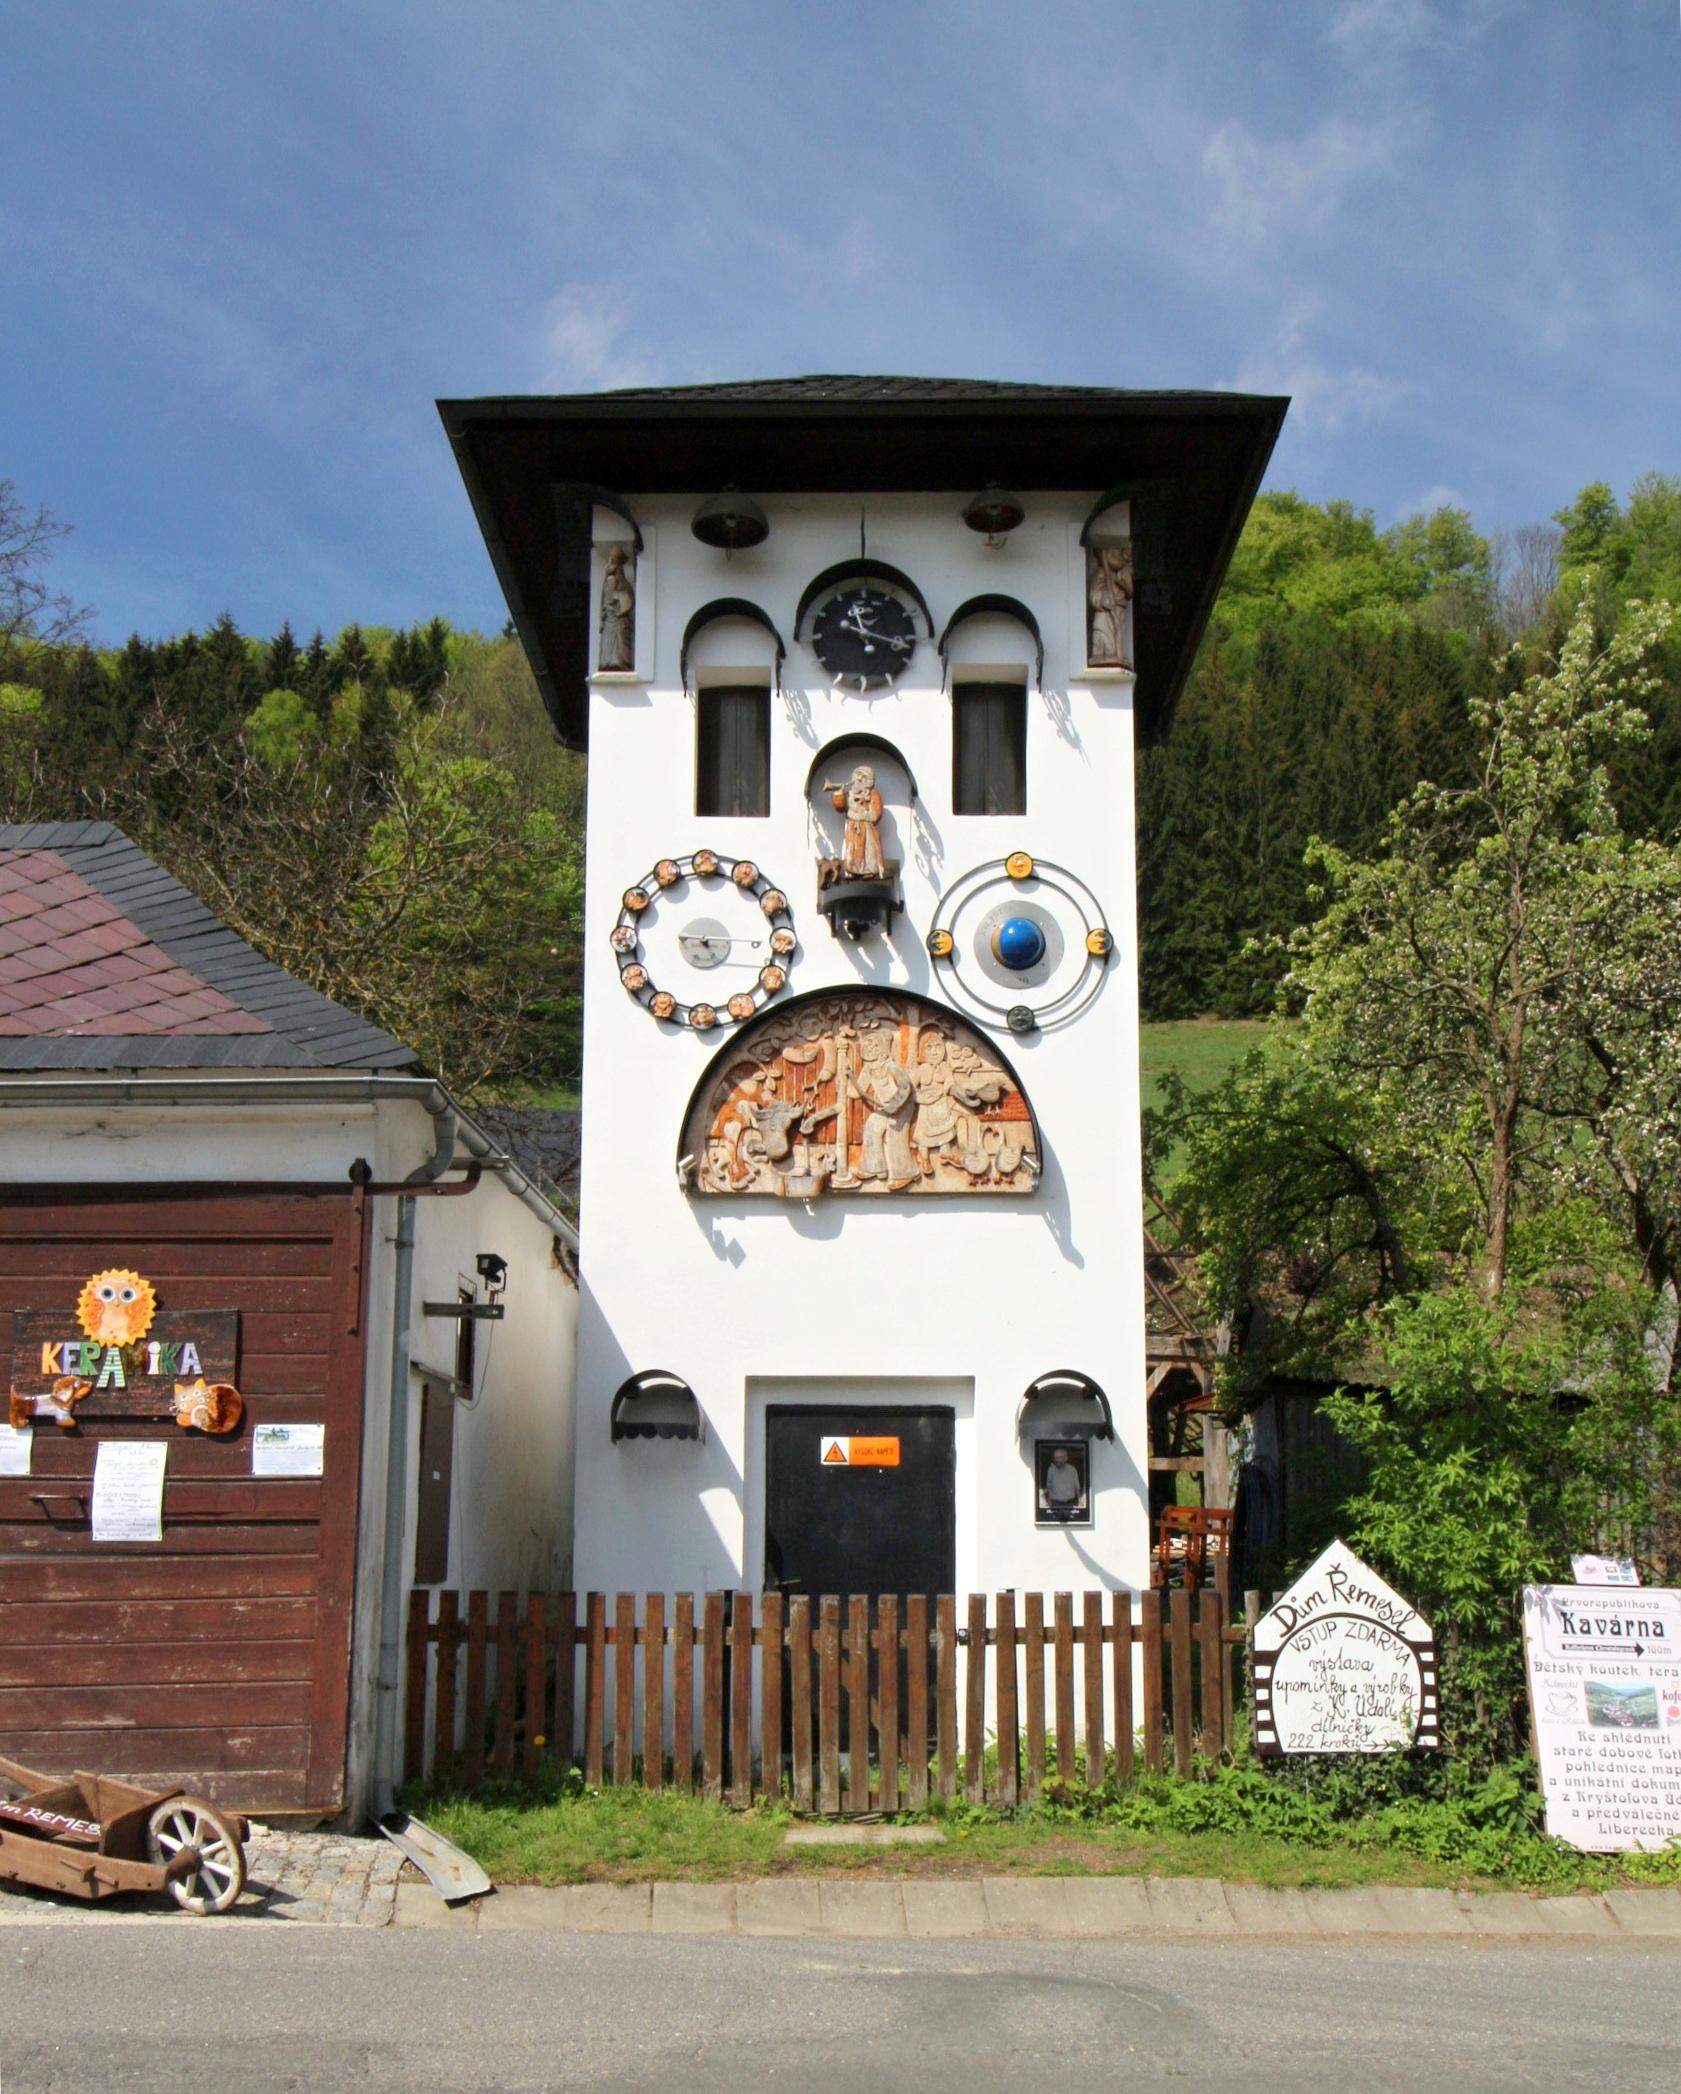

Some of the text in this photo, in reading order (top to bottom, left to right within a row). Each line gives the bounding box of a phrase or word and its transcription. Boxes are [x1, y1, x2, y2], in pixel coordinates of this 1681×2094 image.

[1269, 1562, 1417, 1639] Dům Řemesel
[1560, 1612, 1665, 1638] Kavárna
[1289, 1620, 1412, 1668] VSTUP ZDARMA
[1308, 1647, 1375, 1681] výstava
[1534, 1661, 1584, 1676] Dětský
[1275, 1674, 1349, 1704] upomínky
[1363, 1672, 1418, 1706] výrobky
[1311, 1700, 1323, 1713] z
[1287, 1732, 1315, 1749] 222
[1577, 1730, 1597, 1743] Ke
[1553, 1747, 1593, 1757] staré
[1600, 1747, 1654, 1760] dobové
[1549, 1777, 1557, 1786] a
[1564, 1776, 1625, 1789] unikátní
[1562, 1792, 1571, 1802] z
[1576, 1790, 1659, 1805] Kryštofova
[1571, 1806, 1680, 1821] a předválečné
[1598, 1822, 1675, 1837] Liberecka
